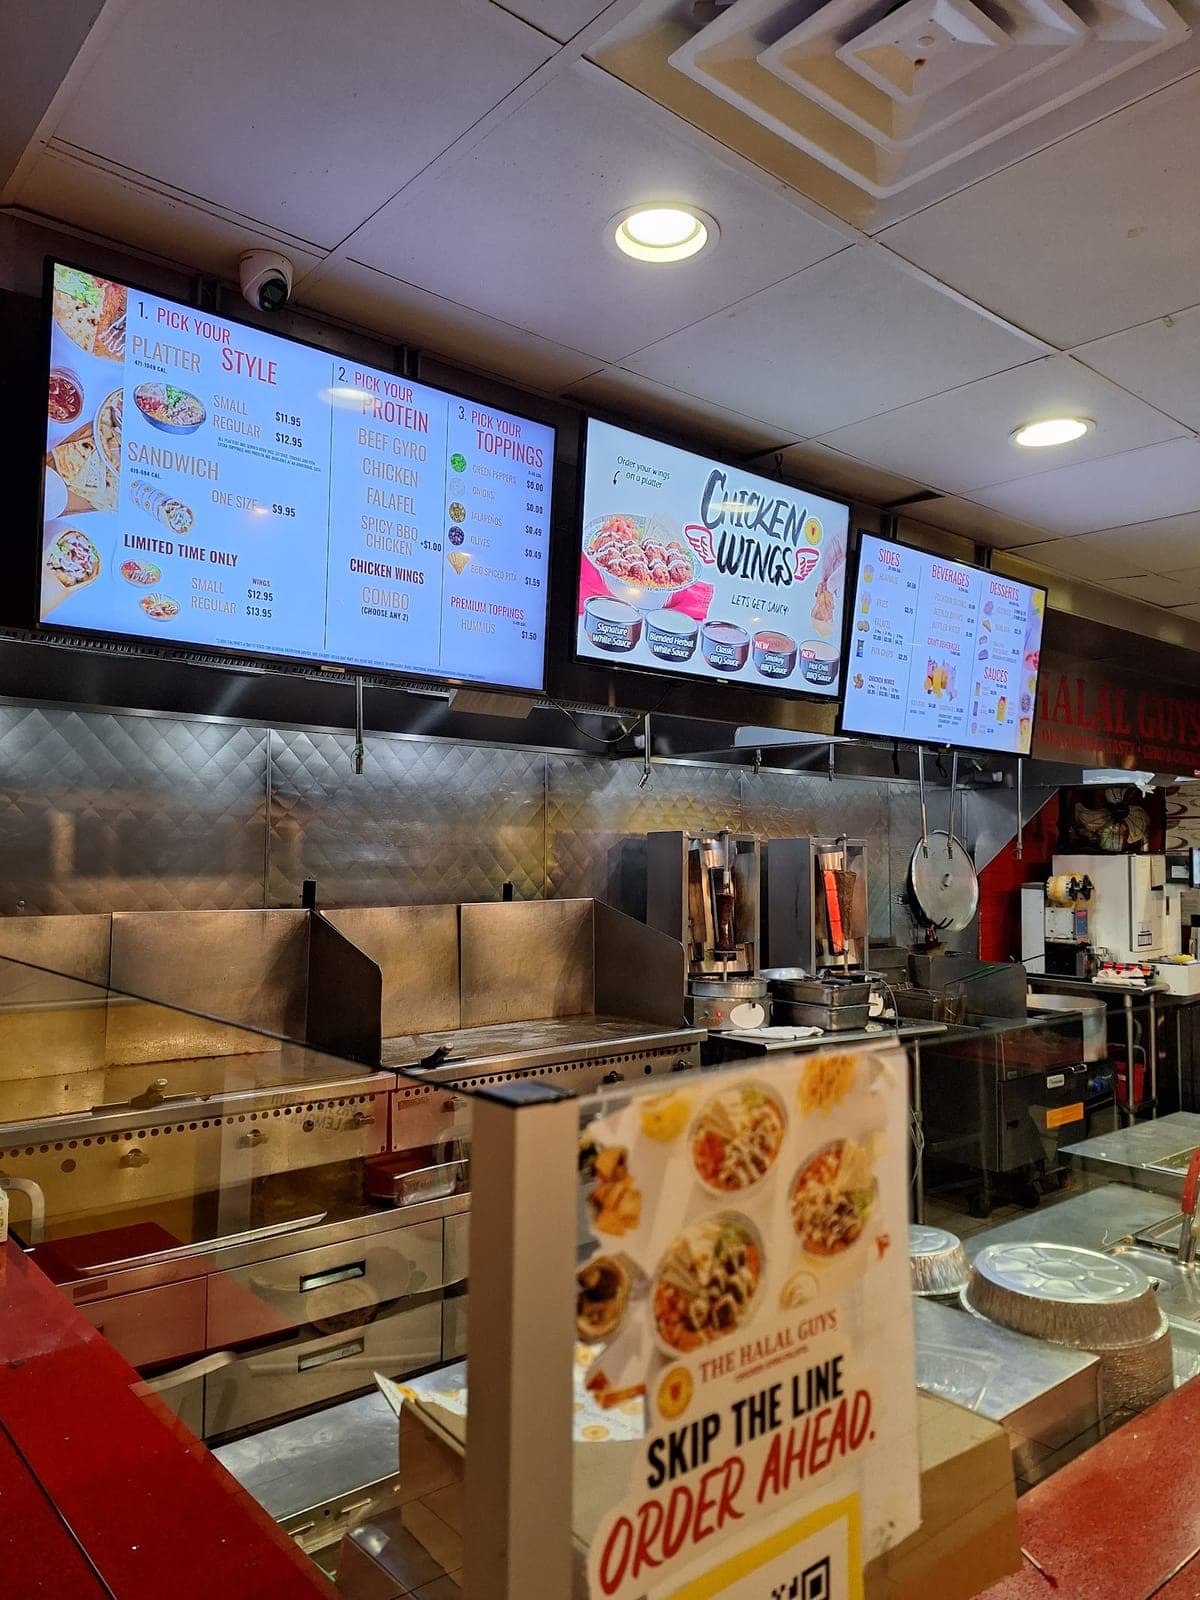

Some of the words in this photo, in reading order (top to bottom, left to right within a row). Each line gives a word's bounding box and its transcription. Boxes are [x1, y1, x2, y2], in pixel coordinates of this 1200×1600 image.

[138, 302, 148, 320] 1.
[156, 307, 189, 331] PICK
[195, 320, 231, 345] YOUR
[132, 335, 201, 373] PLATTER
[221, 347, 278, 385] STYLE
[338, 366, 349, 383] 2.
[354, 371, 380, 393] PICK
[384, 381, 413, 404] YOUR
[213, 394, 248, 416] SMALL
[275, 411, 301, 427] $11.95
[361, 397, 429, 434] PROTEIN
[458, 405, 467, 421] 3.
[471, 410, 493, 430] PICK
[496, 419, 522, 439] YOUR
[212, 413, 262, 439] REGULAR
[275, 432, 303, 448] $12.95
[358, 427, 389, 455] BEEF
[393, 437, 427, 462] GYRO
[476, 429, 544, 469] TOPPINGS
[127, 441, 220, 481] SANDWICH
[362, 457, 419, 489] CHICKEN
[617, 455, 636, 468] Order
[636, 463, 652, 473] your
[472, 464, 492, 477] GREEN
[492, 470, 517, 484] PEPPERS
[526, 480, 544, 492] $0.00
[625, 472, 635, 480] on
[641, 477, 662, 489] platter
[211, 489, 233, 508] ONE
[236, 495, 258, 511] SIZE
[272, 503, 296, 518] $9.95
[366, 486, 417, 516] FALAFEL
[473, 486, 495, 500] ONIONS
[526, 502, 543, 515] $0.00
[700, 469, 807, 547] CHICKEN
[361, 515, 393, 535] SPICY
[396, 523, 418, 542] BBQ
[525, 525, 543, 537] $0.49
[123, 533, 173, 555] LIMITED
[177, 543, 206, 562] TIME
[209, 549, 239, 567] ONLY
[366, 533, 413, 556] CHICKEN
[470, 535, 490, 548] OLIVES
[524, 548, 542, 560] $0.49
[717, 530, 794, 587] WINGS
[879, 548, 900, 567] SIDES
[252, 578, 271, 587] WINGS
[349, 558, 392, 579] CHICKEN
[395, 566, 425, 585] WINGS
[931, 564, 970, 588] BEVERAGES
[191, 577, 225, 594] SMALL
[247, 588, 274, 602] $12.95
[362, 586, 410, 611] COMBO
[731, 594, 750, 608] LETS
[752, 598, 766, 610] GET
[989, 581, 1020, 601] DESSERTS
[191, 595, 237, 614] REGULAR
[246, 605, 272, 619] $13.95
[361, 606, 388, 618] (CHOOSE
[389, 611, 401, 620] ANY
[450, 596, 487, 614] PREMIUM
[488, 603, 525, 621] TOPPINGS
[461, 618, 496, 634] HUMMUS
[521, 630, 537, 641] $1.50
[592, 633, 613, 645] White
[613, 636, 633, 649] Sauce
[597, 623, 628, 637] Signature
[649, 632, 674, 645] Blended
[674, 636, 694, 648] Herbal
[653, 644, 672, 656] White
[672, 648, 690, 659] Sauce
[715, 644, 734, 656] Classic
[755, 640, 770, 650] NEW
[801, 649, 815, 659] NEW
[710, 654, 724, 666] BBQ
[724, 656, 740, 667] Sauce
[983, 666, 1008, 683] SAUCES
[699, 1350, 735, 1384] THE
[740, 1327, 793, 1367] HALAL
[797, 1308, 838, 1341] GUYS
[646, 1412, 721, 1489] SKIP
[731, 1383, 783, 1447] THE
[792, 1355, 844, 1420] LINE
[599, 1456, 745, 1596] ORDER
[757, 1389, 876, 1504] AHEAD.
